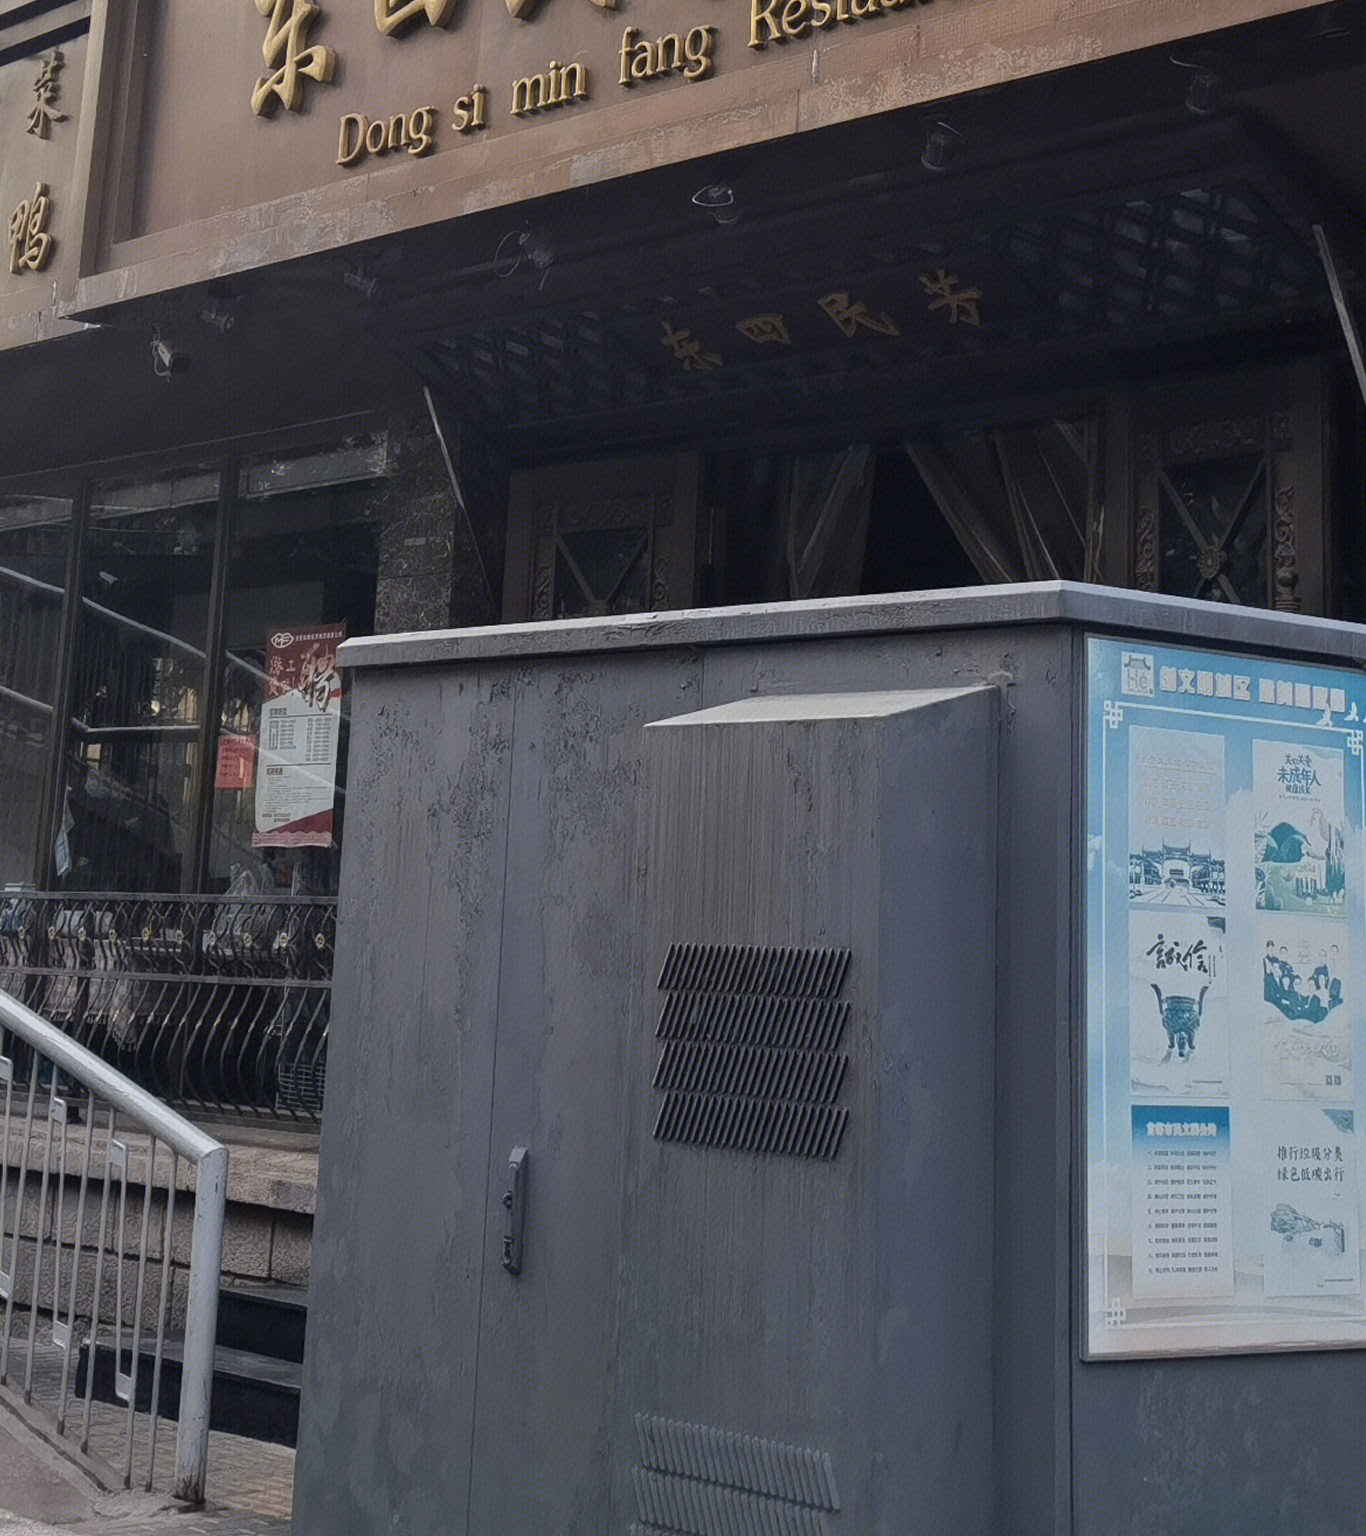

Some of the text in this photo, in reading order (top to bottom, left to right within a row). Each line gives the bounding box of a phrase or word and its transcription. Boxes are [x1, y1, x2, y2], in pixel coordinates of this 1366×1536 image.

[336, 104, 435, 167] Dong
[451, 83, 486, 133] si
[510, 58, 587, 116] min
[617, 23, 715, 86] fang
[1276, 766, 1322, 787] 未成年人
[1277, 1145, 1343, 1162] 推行垃圾分类
[1277, 1166, 1344, 1182] 绿色低碳出行
